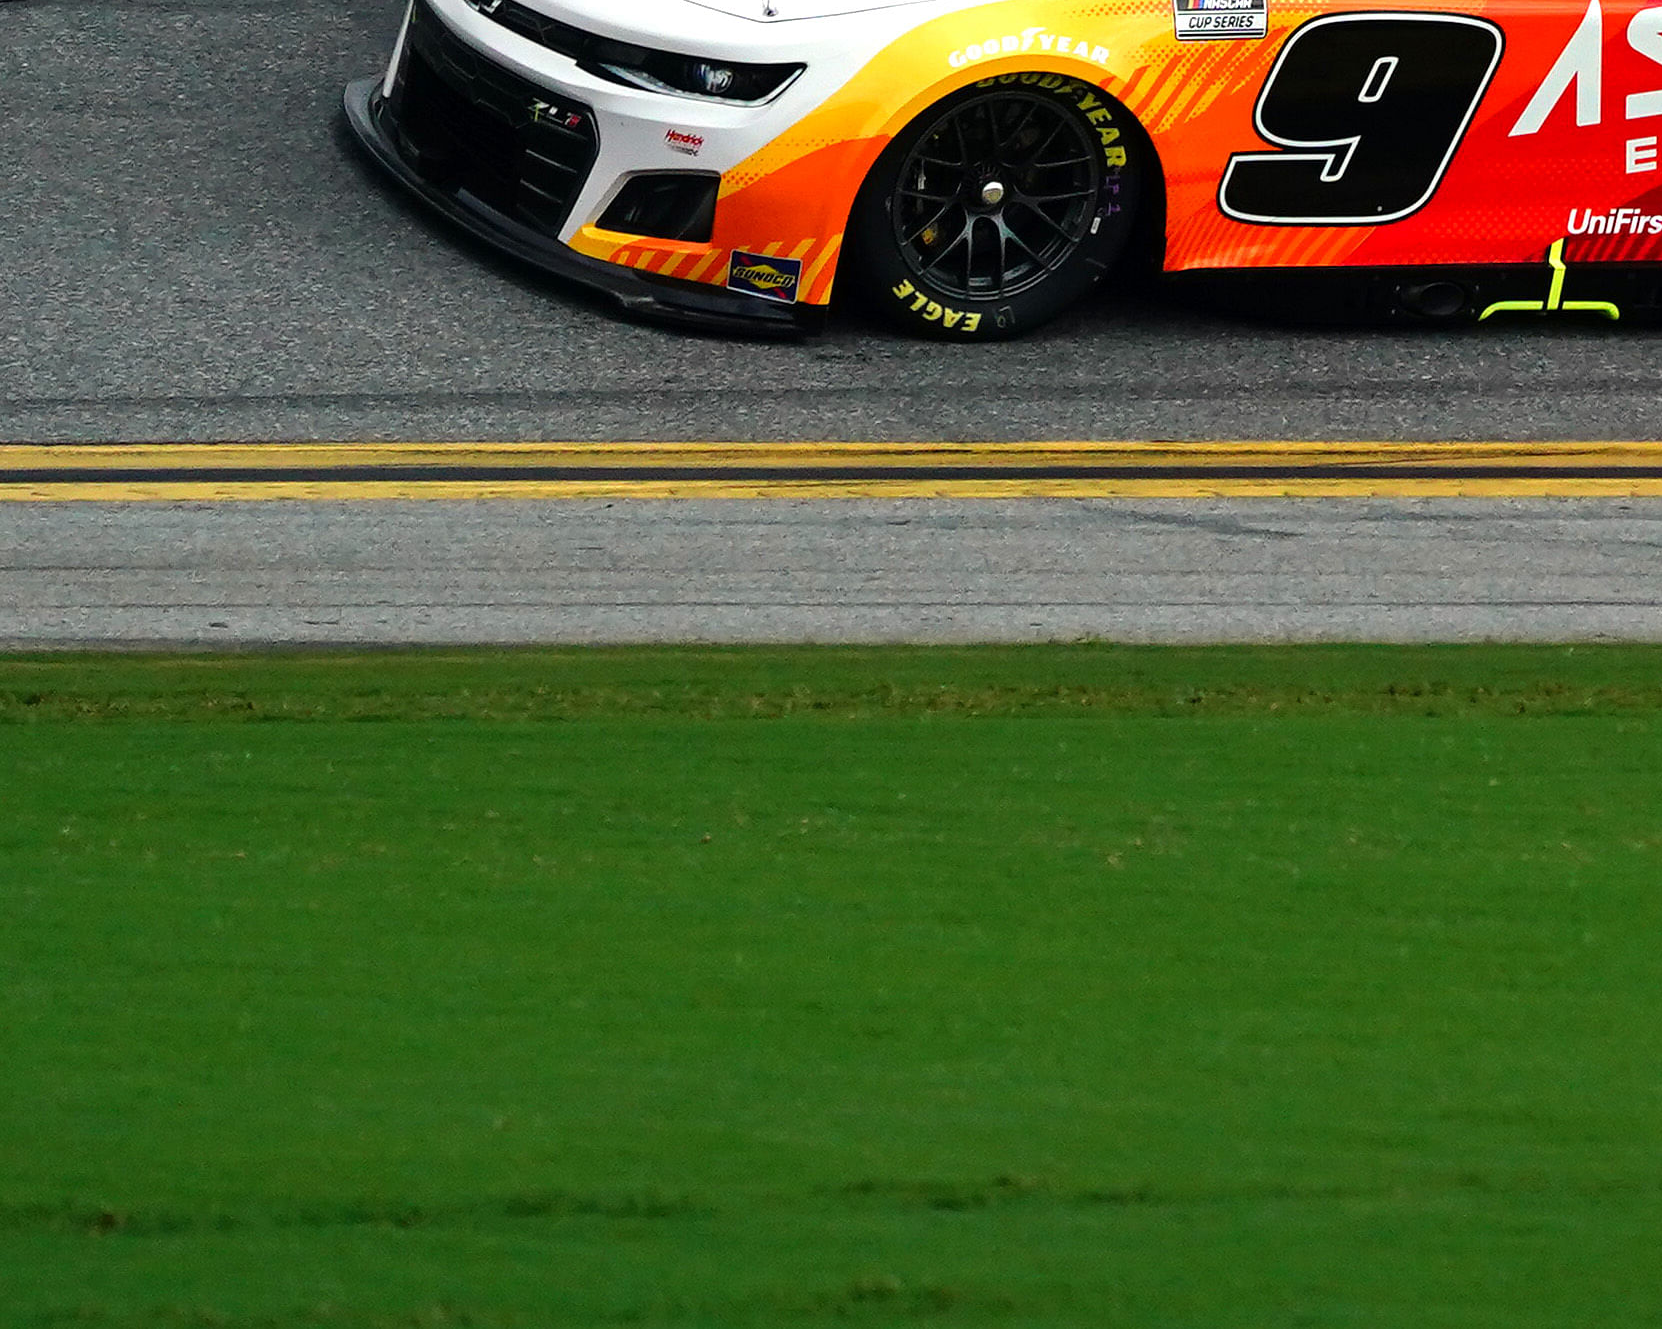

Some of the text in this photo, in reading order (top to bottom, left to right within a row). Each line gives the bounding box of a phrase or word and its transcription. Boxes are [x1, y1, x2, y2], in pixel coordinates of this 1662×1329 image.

[1188, 15, 1255, 29] CUP SERIES
[948, 26, 1111, 68] GOODYEAR
[1216, 9, 1507, 227] 9
[733, 266, 796, 290] SUNOCO
[891, 278, 982, 333] EAGLE
